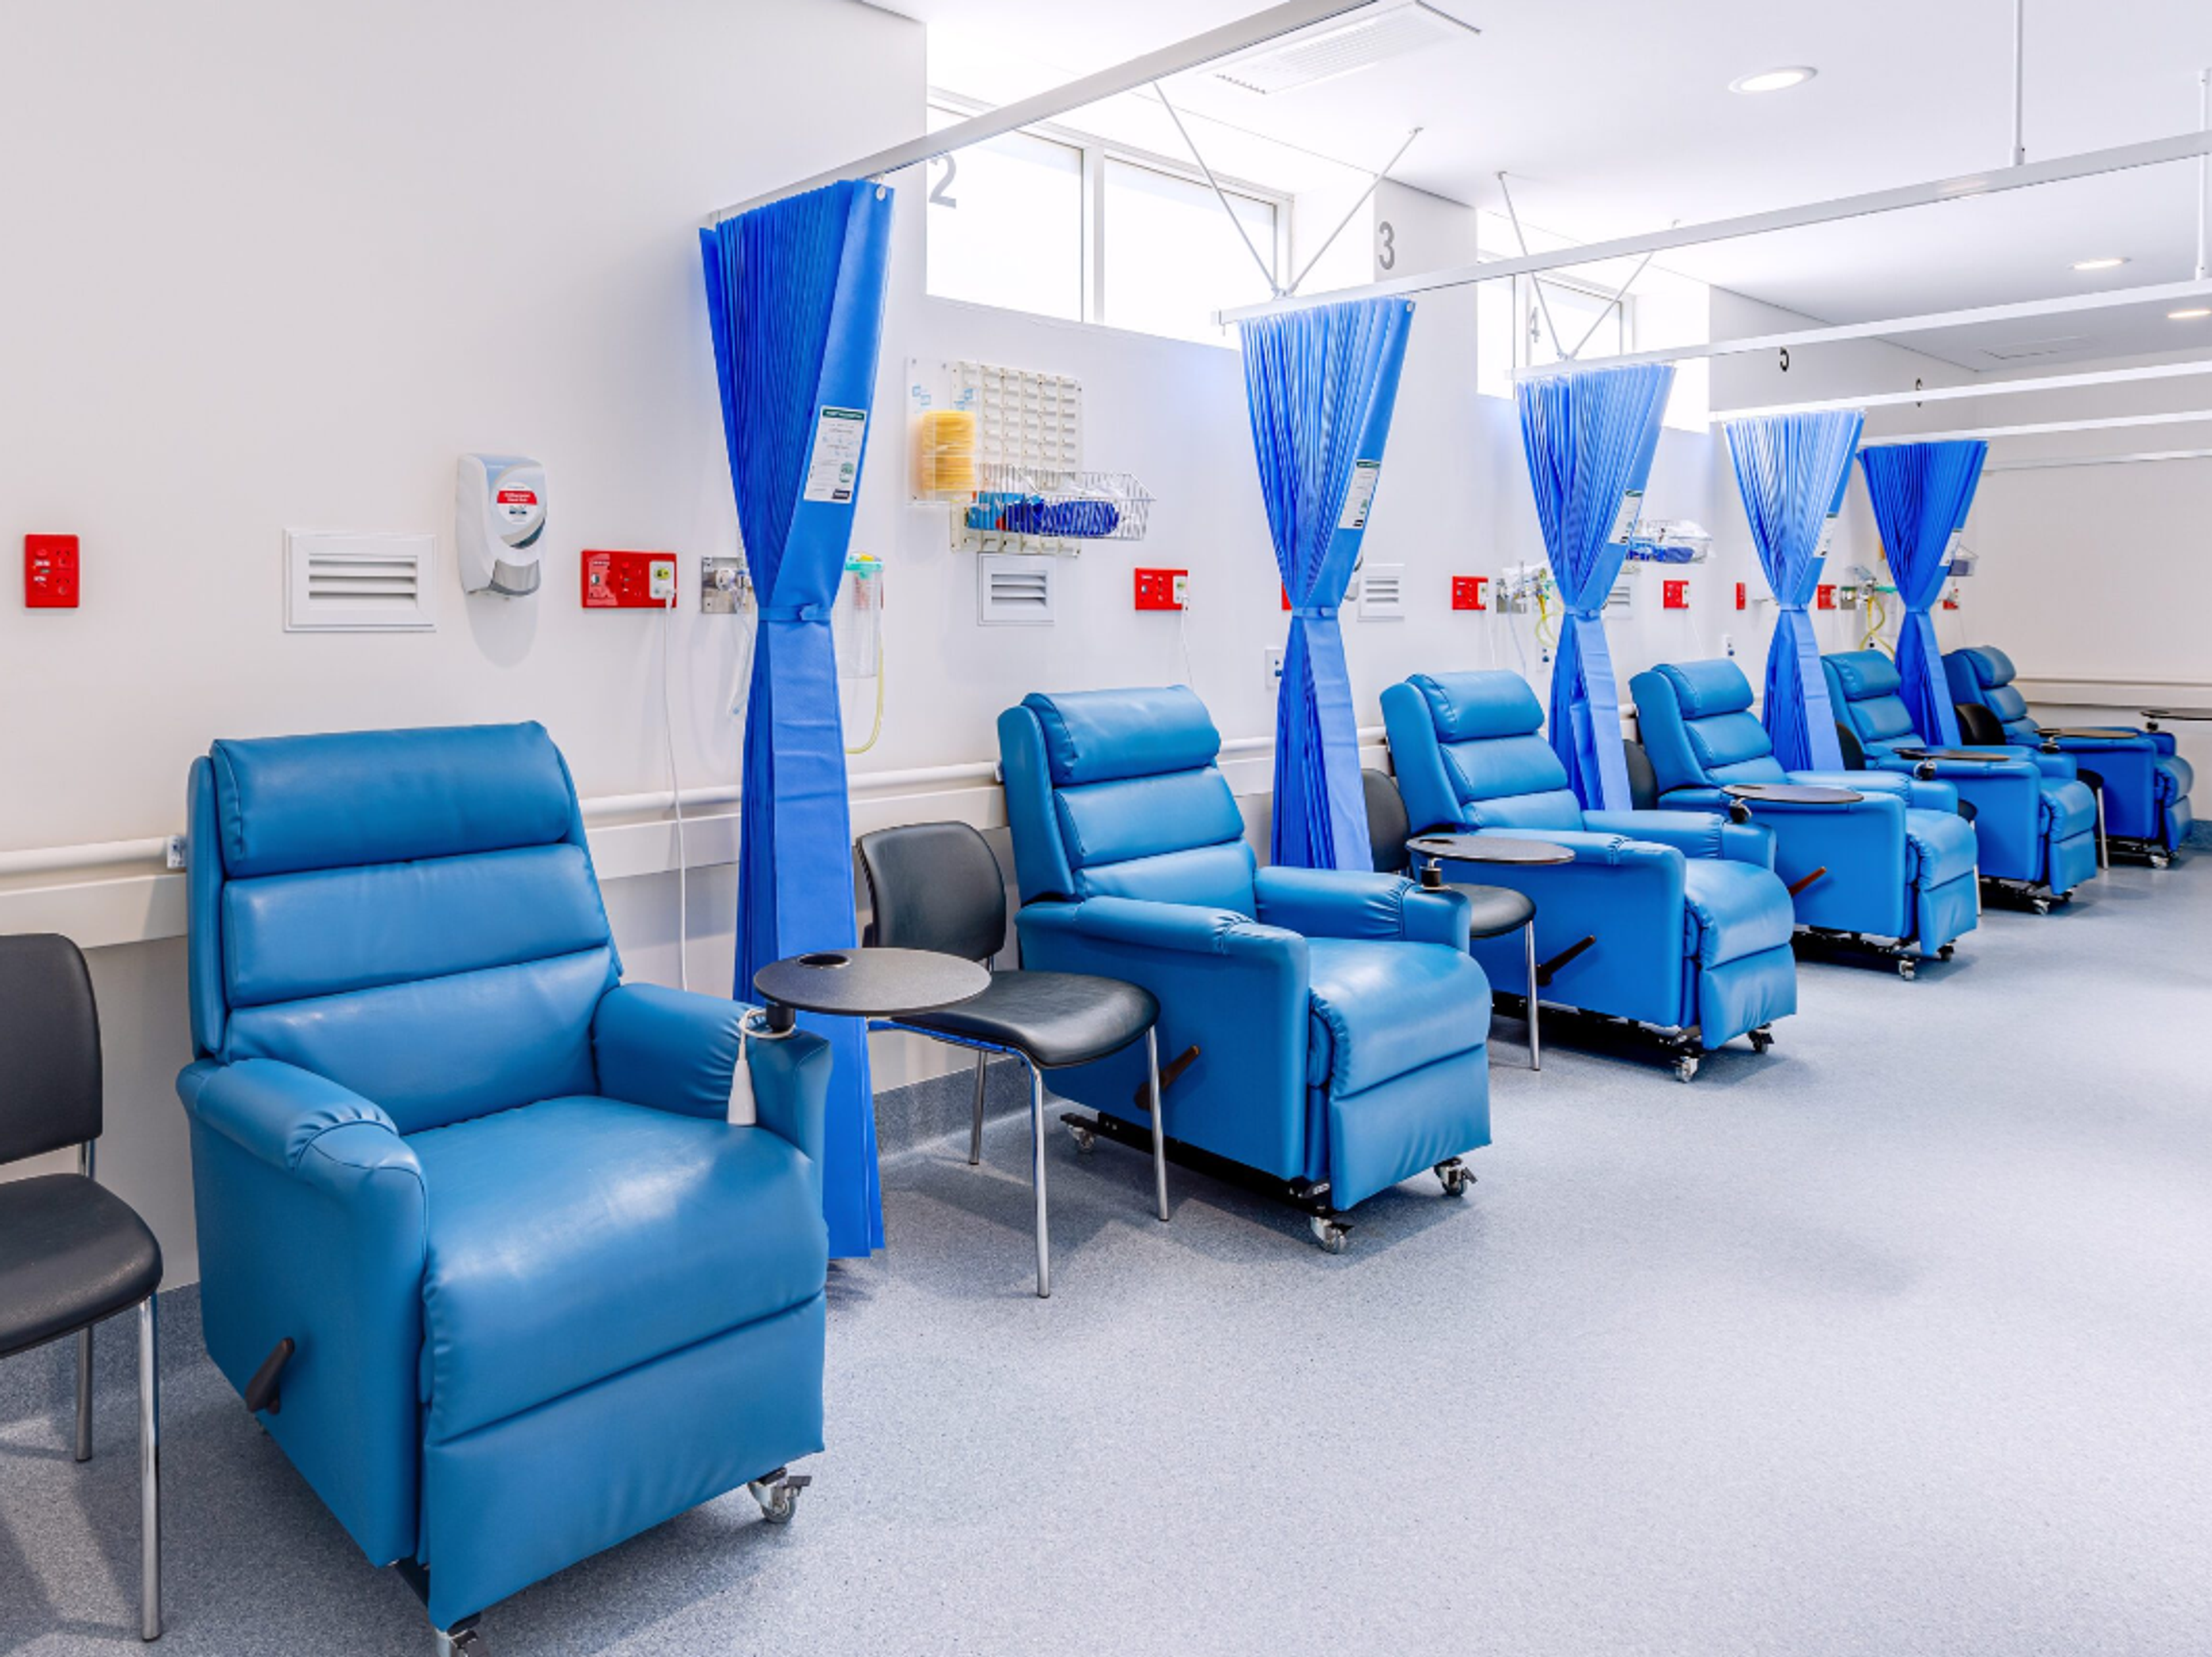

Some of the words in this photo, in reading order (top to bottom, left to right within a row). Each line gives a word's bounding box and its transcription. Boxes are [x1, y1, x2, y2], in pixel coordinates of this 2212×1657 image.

[929, 153, 956, 209] 2
[1379, 221, 1395, 270] 3
[1529, 307, 1540, 343] 4
[1780, 347, 1789, 372] 5
